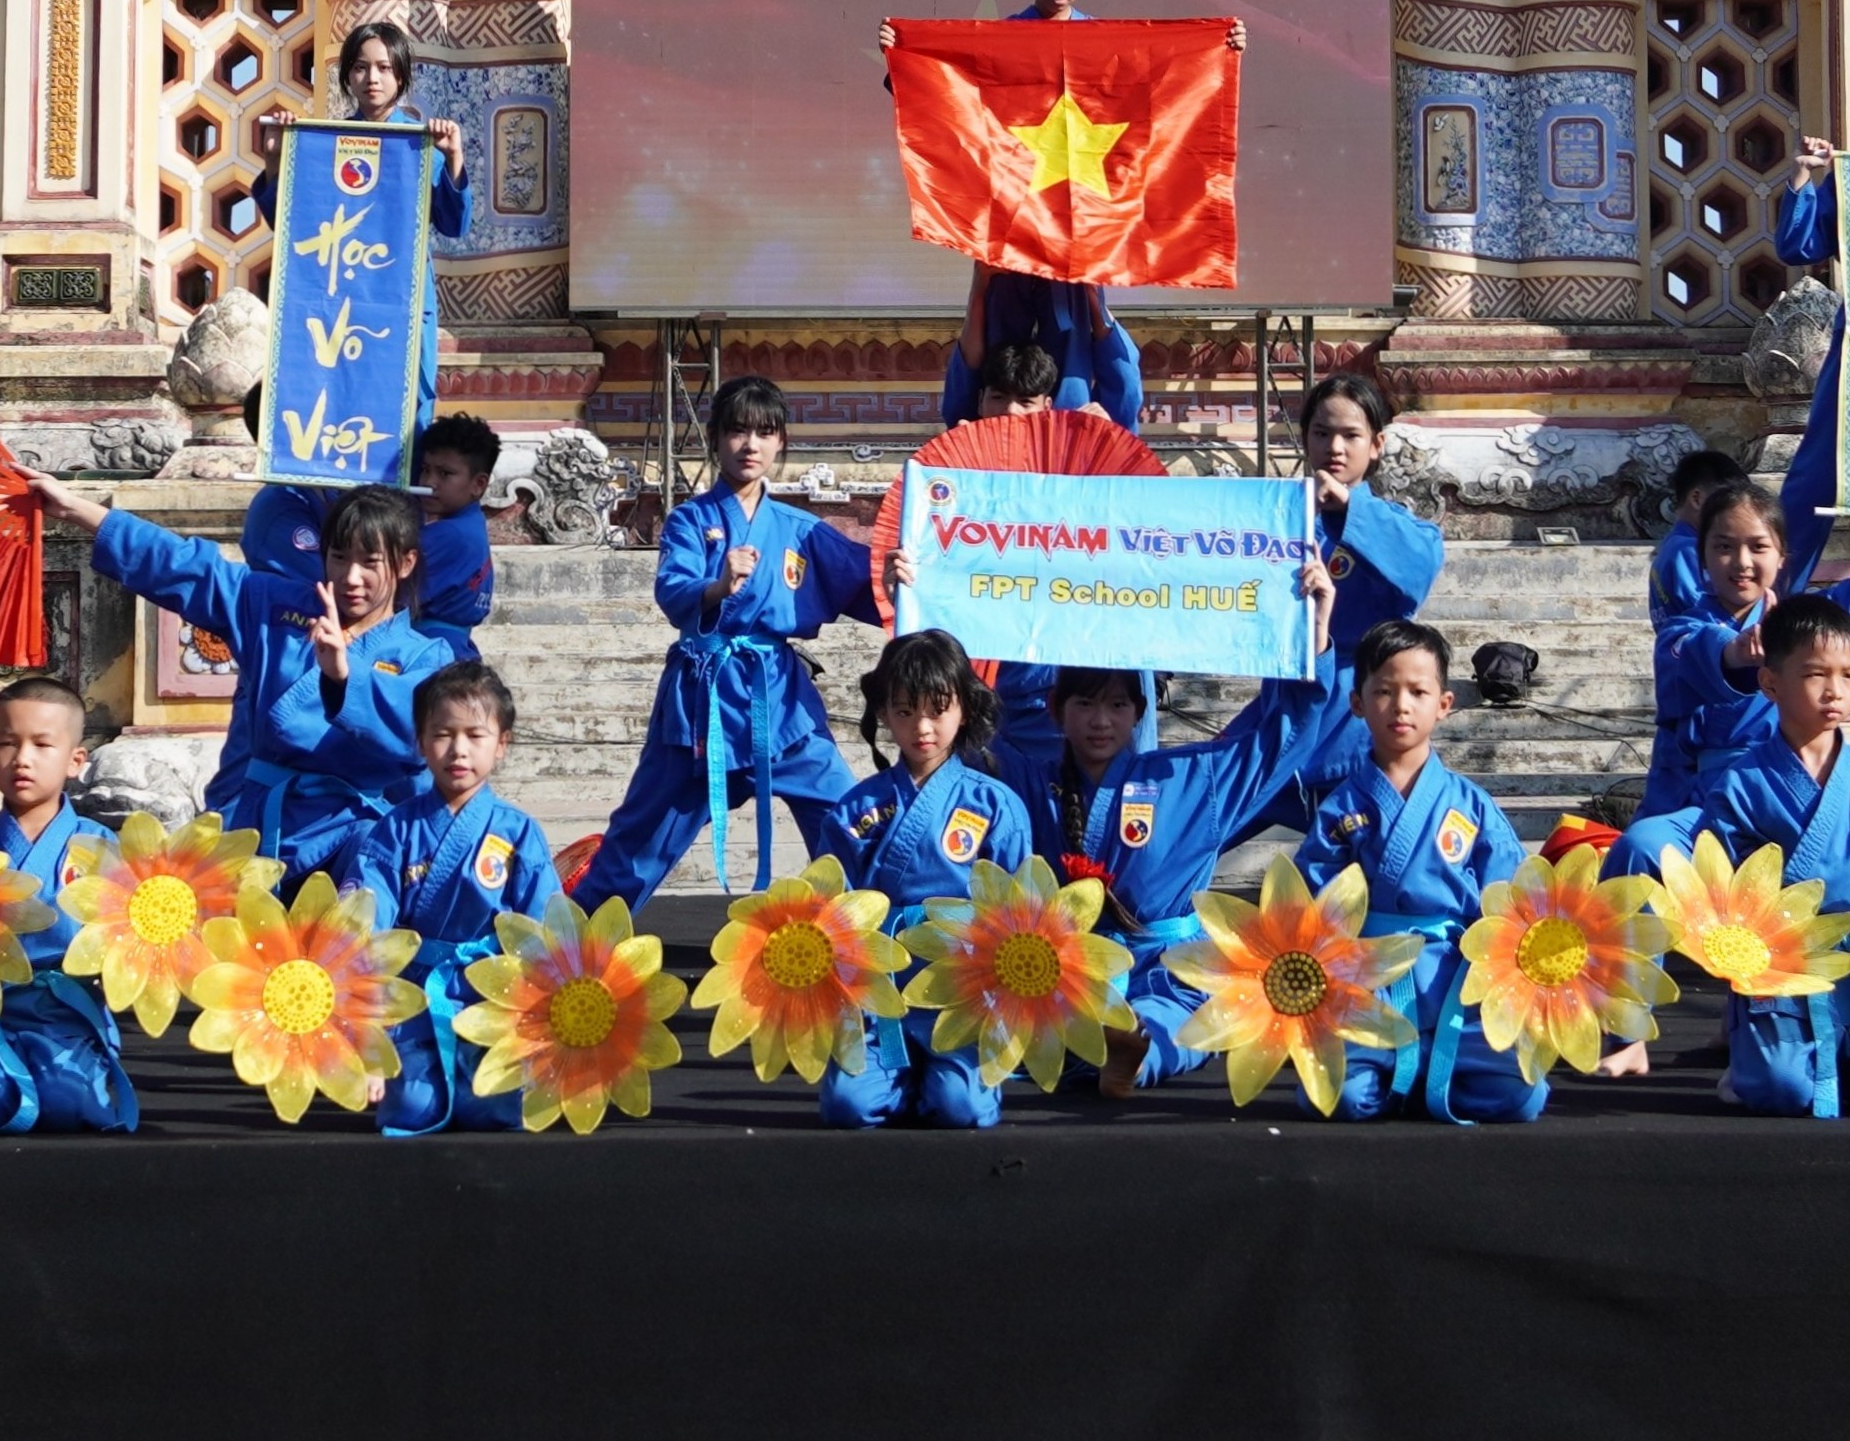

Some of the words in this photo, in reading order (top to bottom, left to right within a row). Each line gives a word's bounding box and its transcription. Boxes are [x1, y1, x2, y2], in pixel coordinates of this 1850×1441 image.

[293, 201, 396, 297] Học
[306, 295, 391, 369] Võ
[282, 387, 396, 473] Việt
[929, 512, 1109, 560] VOVINAM
[1192, 528, 1237, 557] VÕ
[970, 573, 1038, 601] FPT
[1048, 577, 1170, 609] School
[1182, 579, 1263, 612] HUẾ
